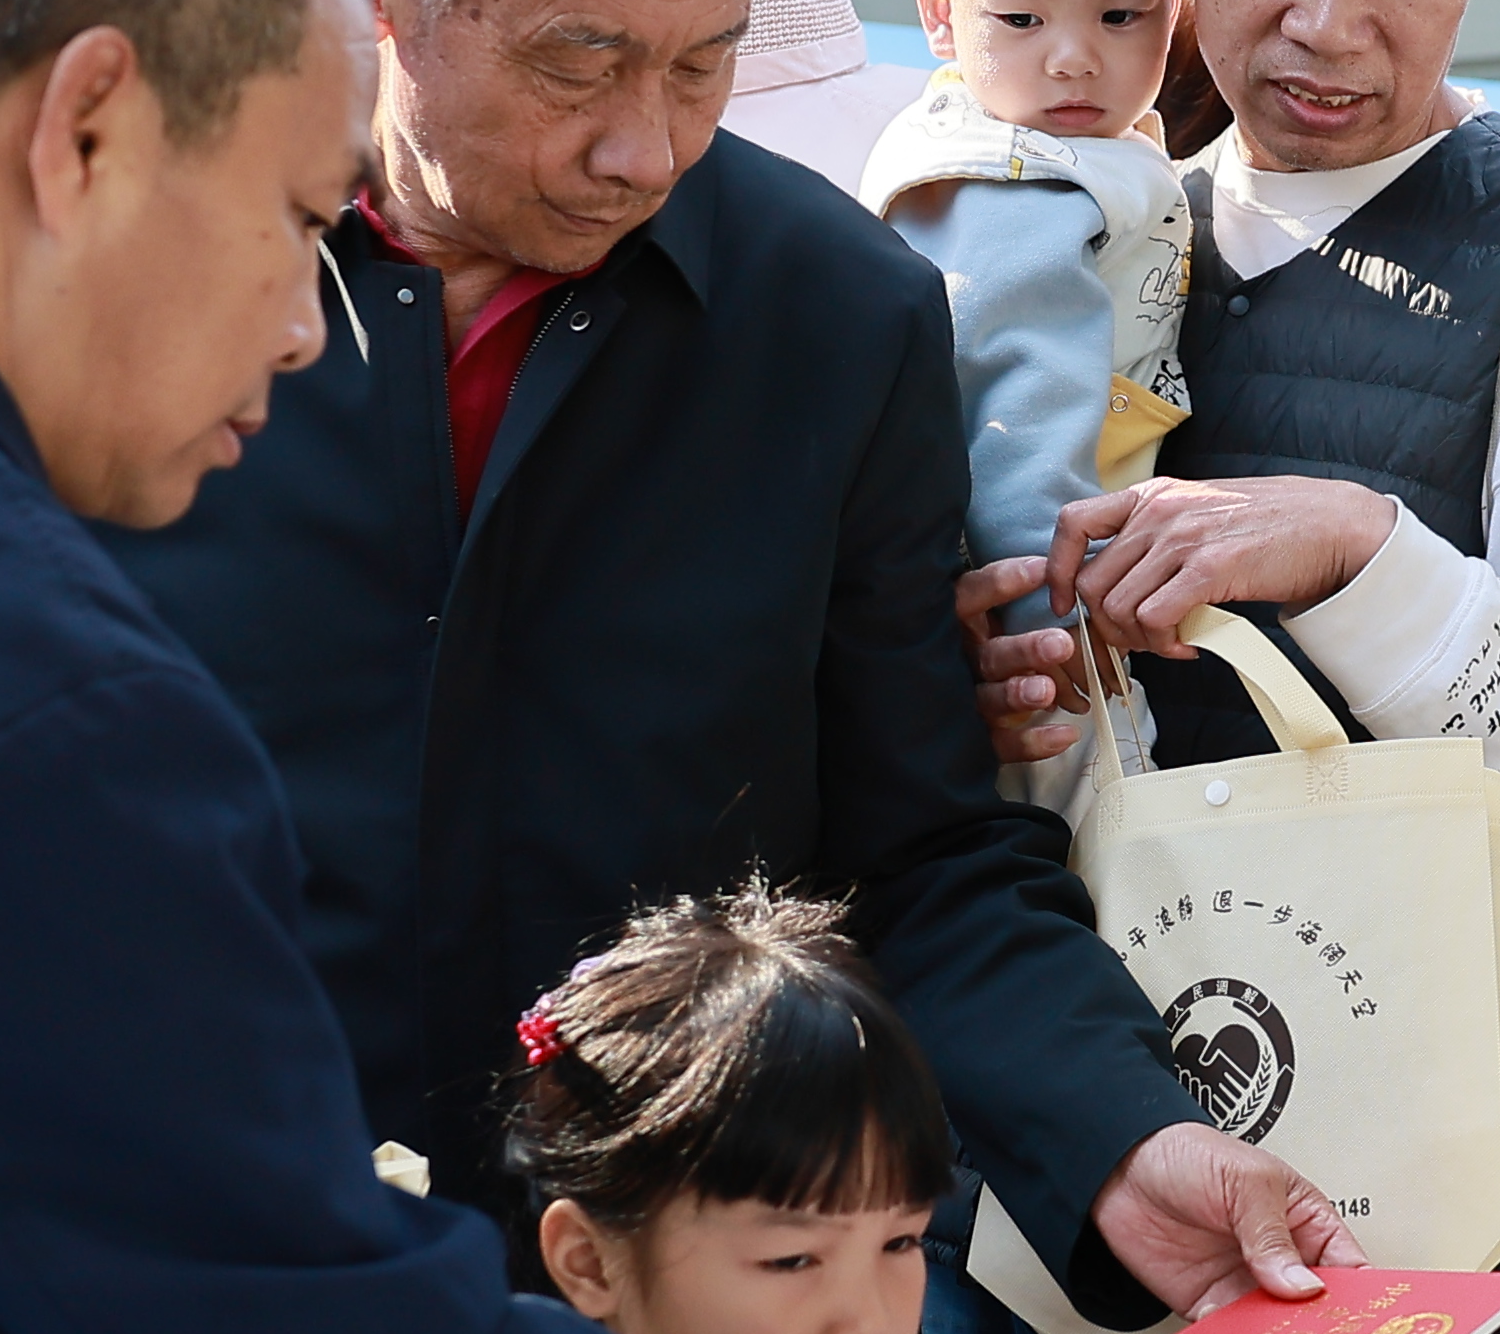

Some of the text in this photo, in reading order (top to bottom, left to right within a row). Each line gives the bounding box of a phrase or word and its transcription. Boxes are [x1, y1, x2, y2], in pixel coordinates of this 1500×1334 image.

[1118, 889, 1379, 1020] 平浪静 退一步海阔天空
[1171, 978, 1261, 1020] 人民调解
